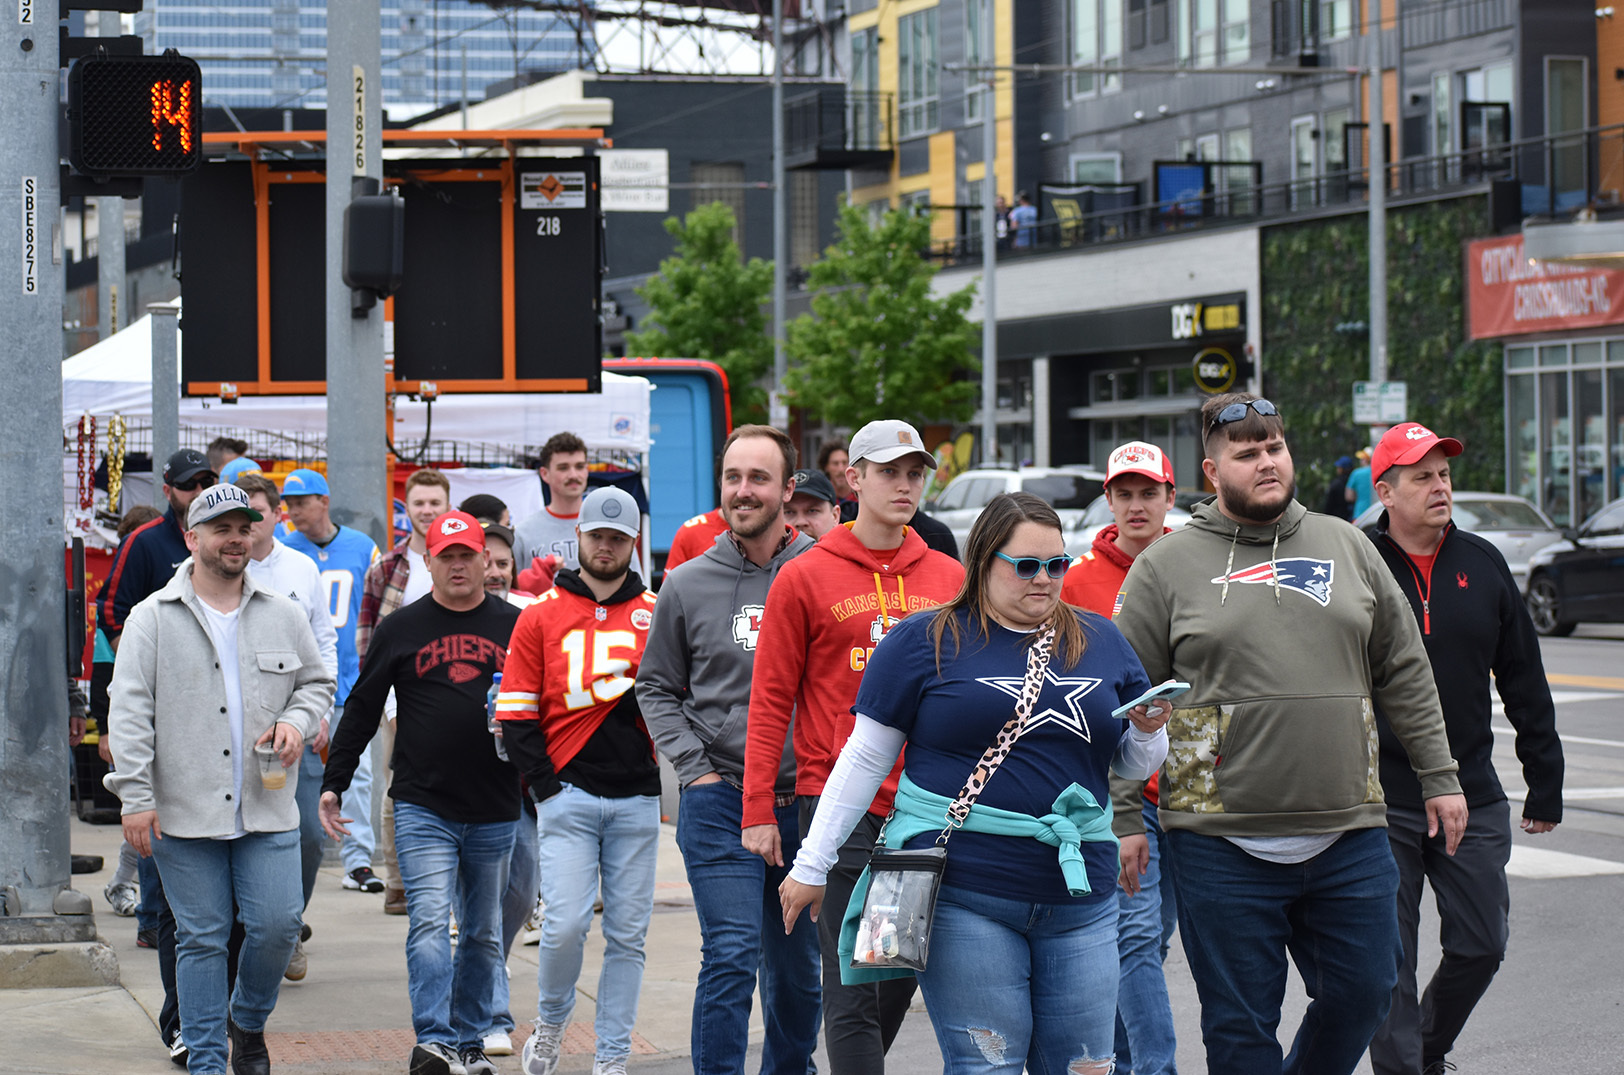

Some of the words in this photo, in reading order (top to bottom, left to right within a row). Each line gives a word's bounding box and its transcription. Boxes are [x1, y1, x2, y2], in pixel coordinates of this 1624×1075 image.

[151, 80, 191, 154] 14
[355, 77, 364, 168] 21826
[24, 178, 35, 292] SBE8275
[536, 216, 561, 236] 218
[1171, 302, 1203, 340] DGX
[206, 488, 249, 510] DALLAS
[561, 629, 637, 711] 15
